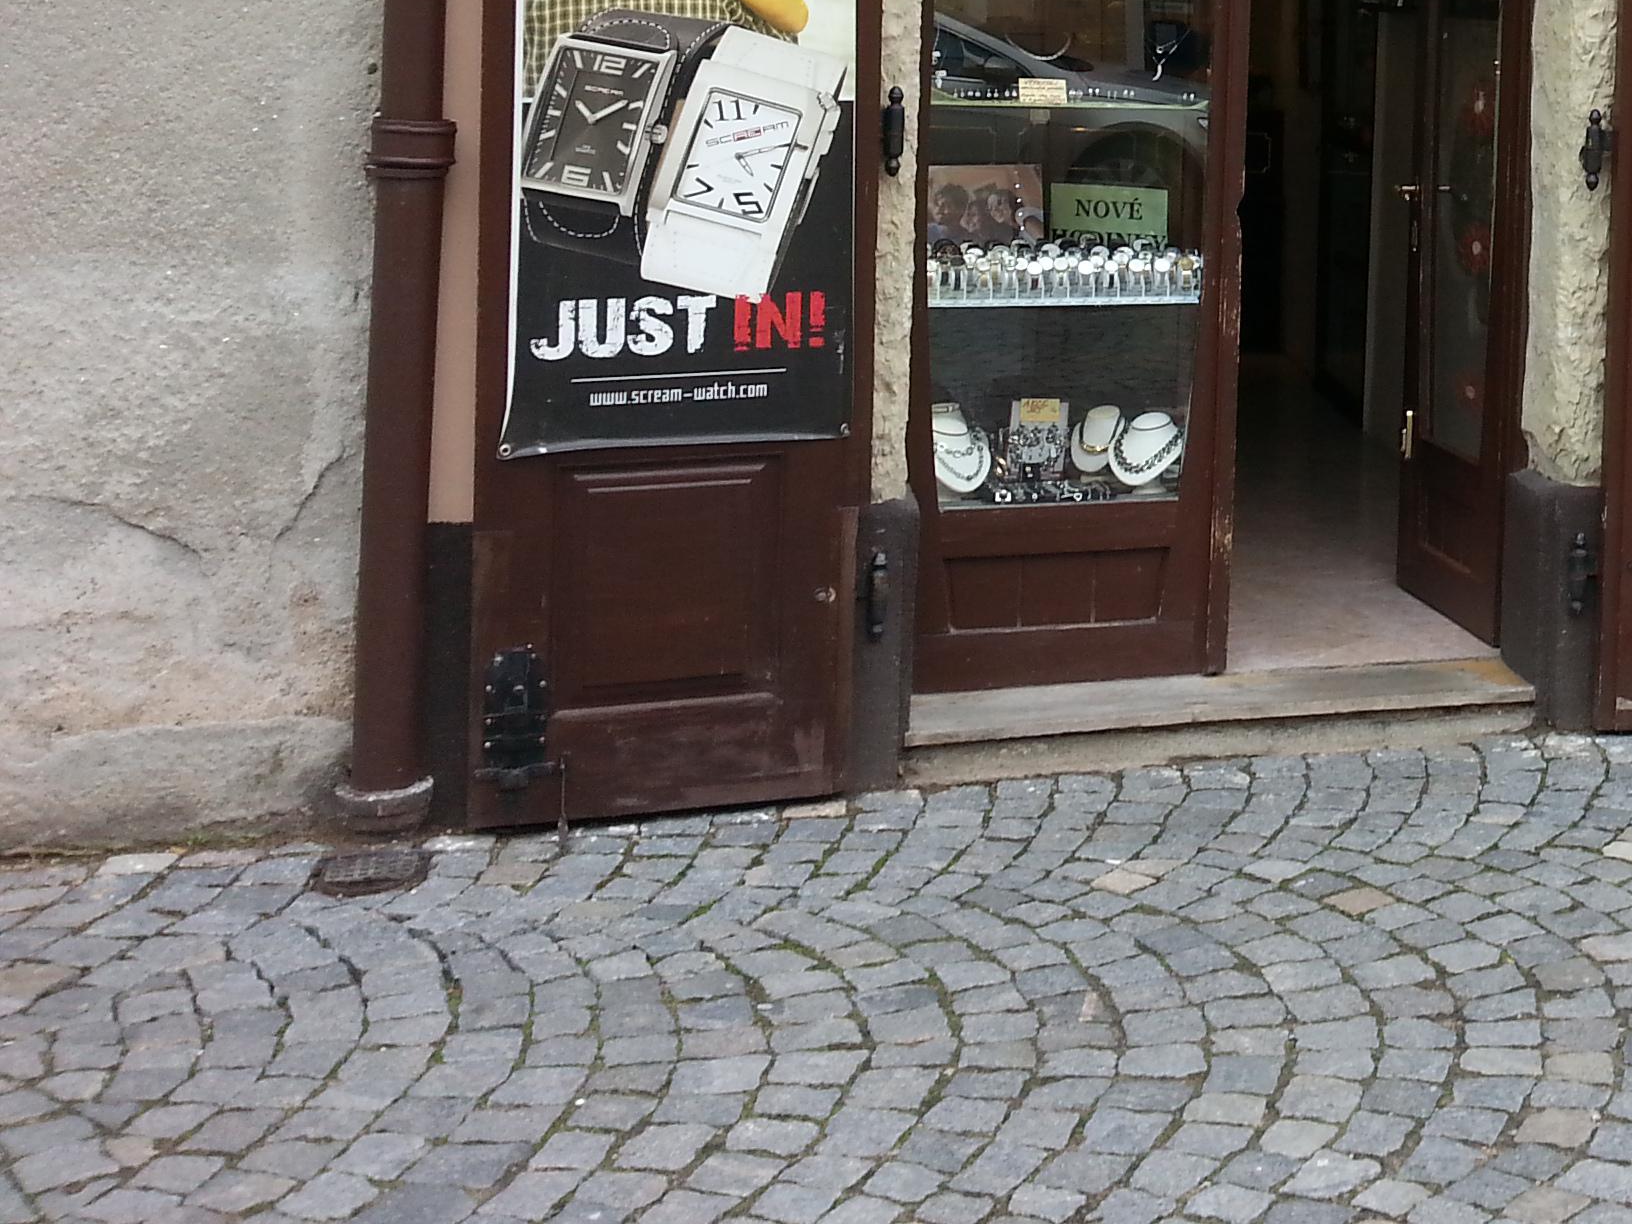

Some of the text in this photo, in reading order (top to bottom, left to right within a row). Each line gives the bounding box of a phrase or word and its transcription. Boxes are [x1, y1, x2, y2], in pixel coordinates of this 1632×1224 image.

[593, 54, 627, 76] 12
[712, 98, 747, 122] 11
[705, 120, 790, 148] SCREAM
[561, 164, 592, 187] 6
[683, 177, 714, 198] 7
[733, 192, 764, 216] 5
[1075, 197, 1143, 221] NOVÉ
[530, 291, 826, 361] JUST IN!
[589, 381, 768, 407] www.scream-watch.com
